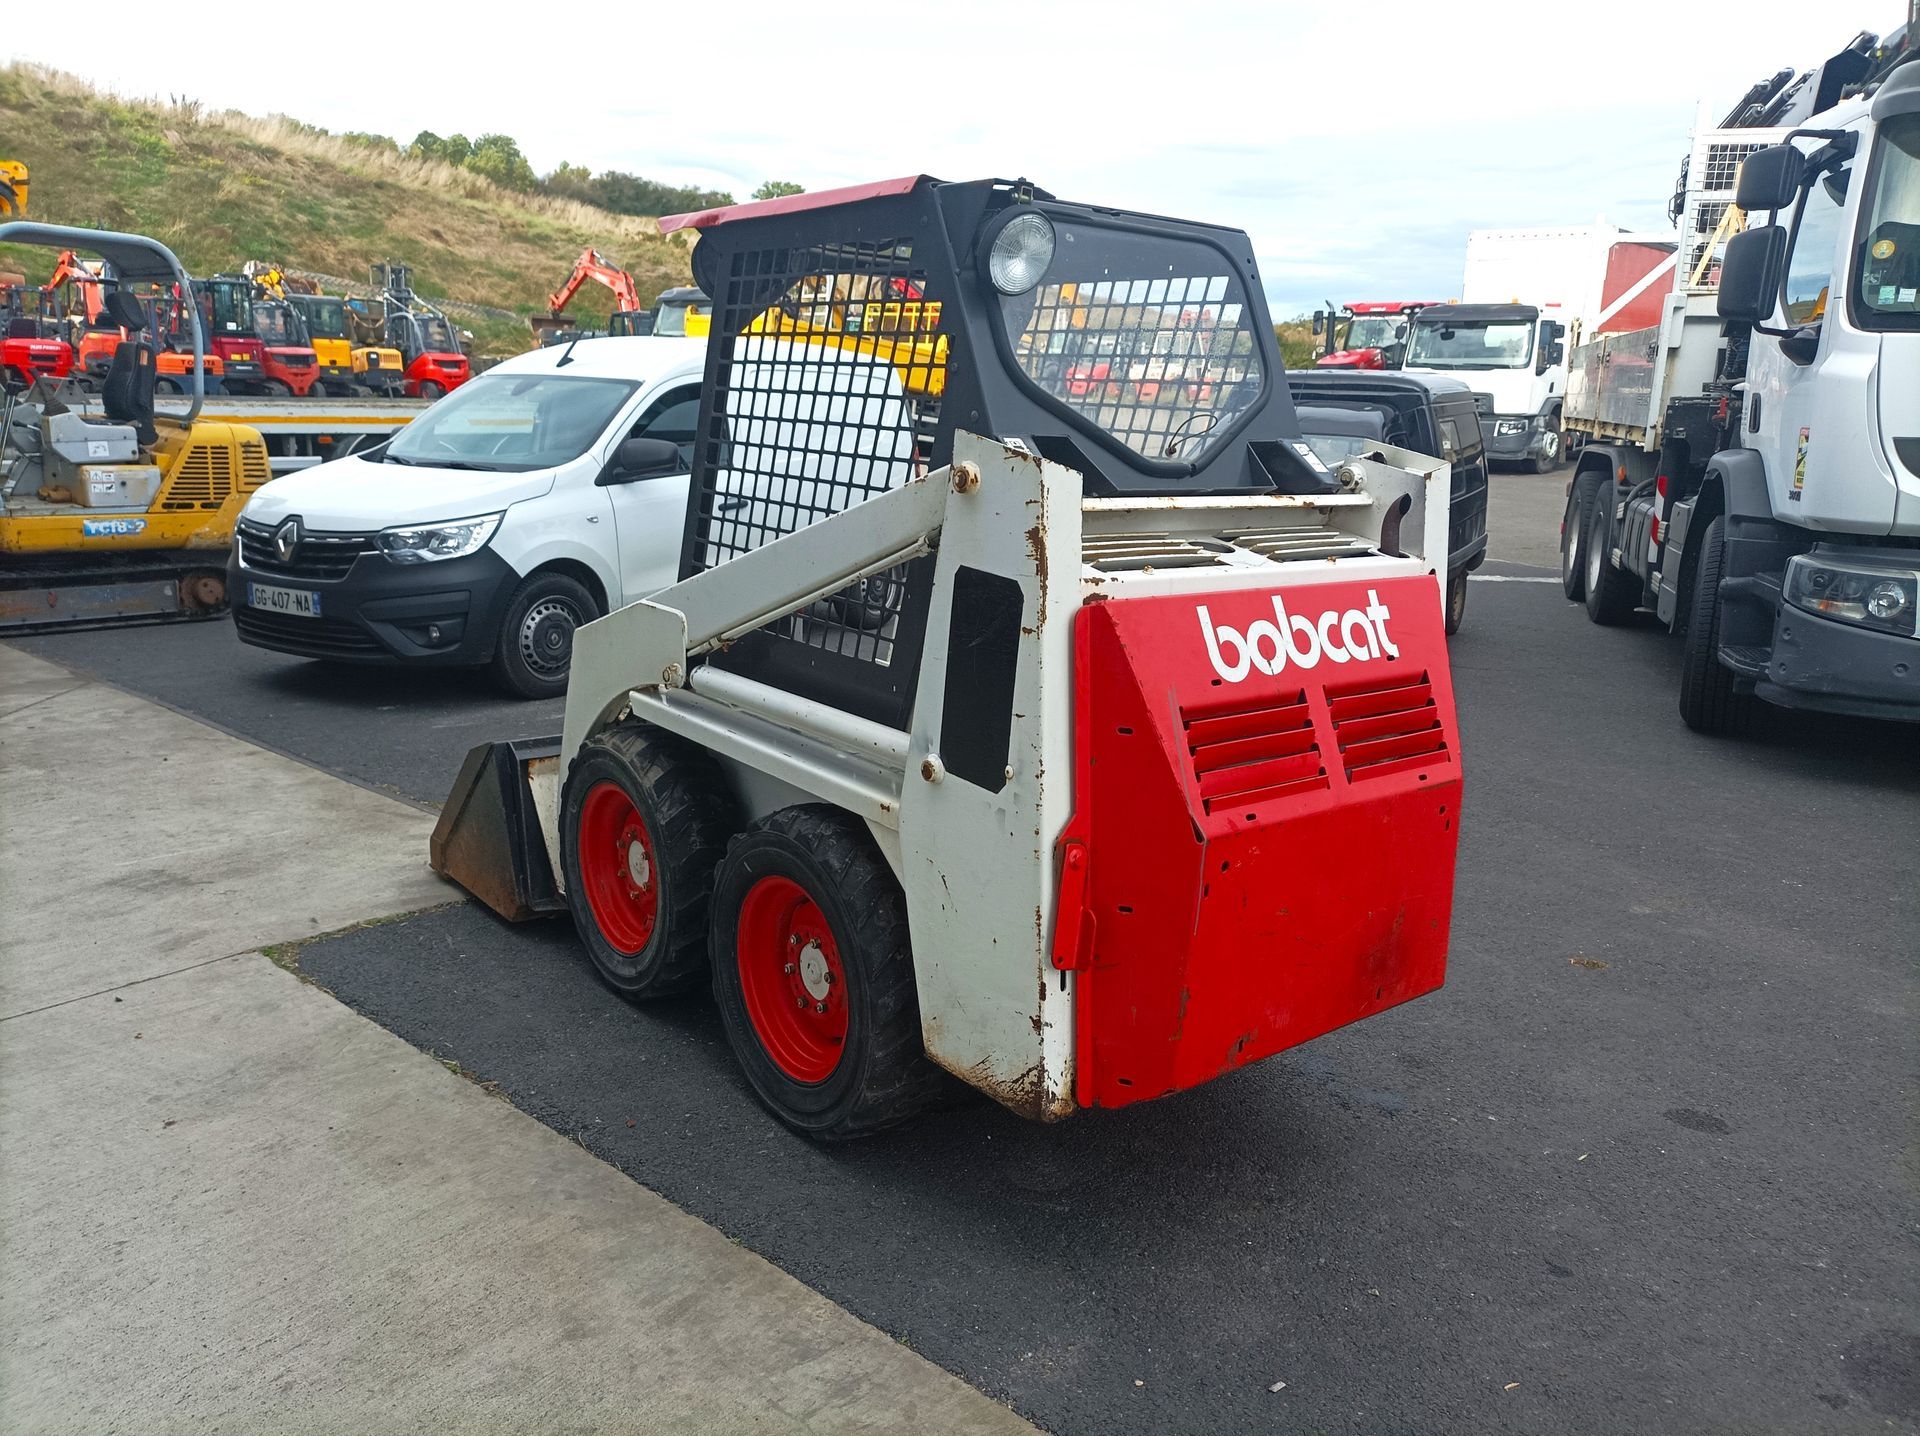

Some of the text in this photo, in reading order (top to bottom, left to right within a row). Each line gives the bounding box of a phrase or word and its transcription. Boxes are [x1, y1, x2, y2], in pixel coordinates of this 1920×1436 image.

[181, 359, 216, 367] TOOTA
[254, 588, 311, 613] GG-407-NA
[1196, 589, 1400, 683] bobcat
